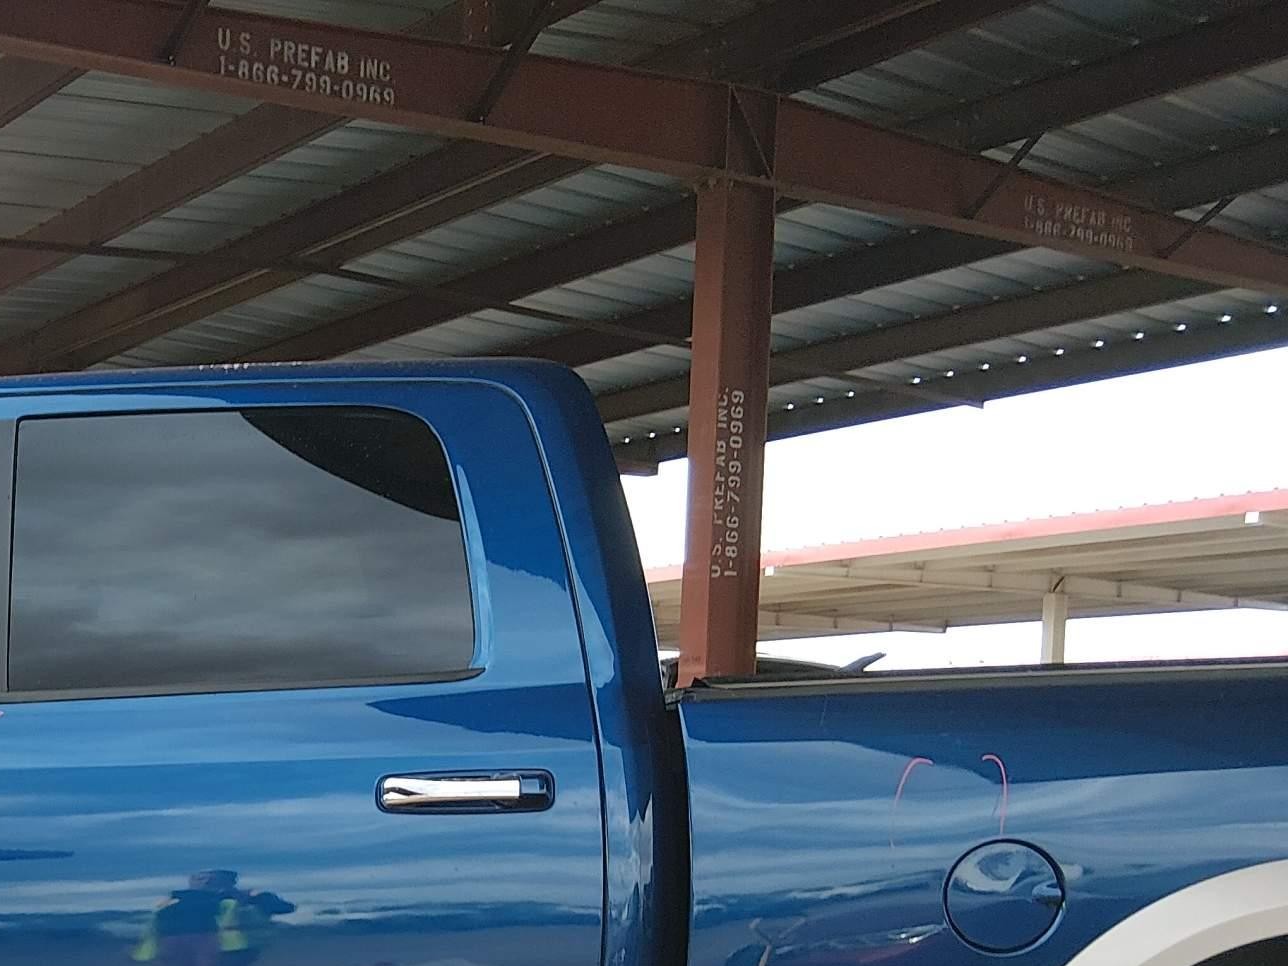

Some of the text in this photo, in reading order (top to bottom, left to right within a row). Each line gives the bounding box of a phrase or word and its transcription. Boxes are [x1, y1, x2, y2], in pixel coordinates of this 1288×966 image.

[218, 54, 396, 105] 1-866-799-0969
[269, 38, 349, 75] PREFAB
[713, 440, 726, 525] PREFAB
[724, 389, 745, 577] 1-866-799-0969
